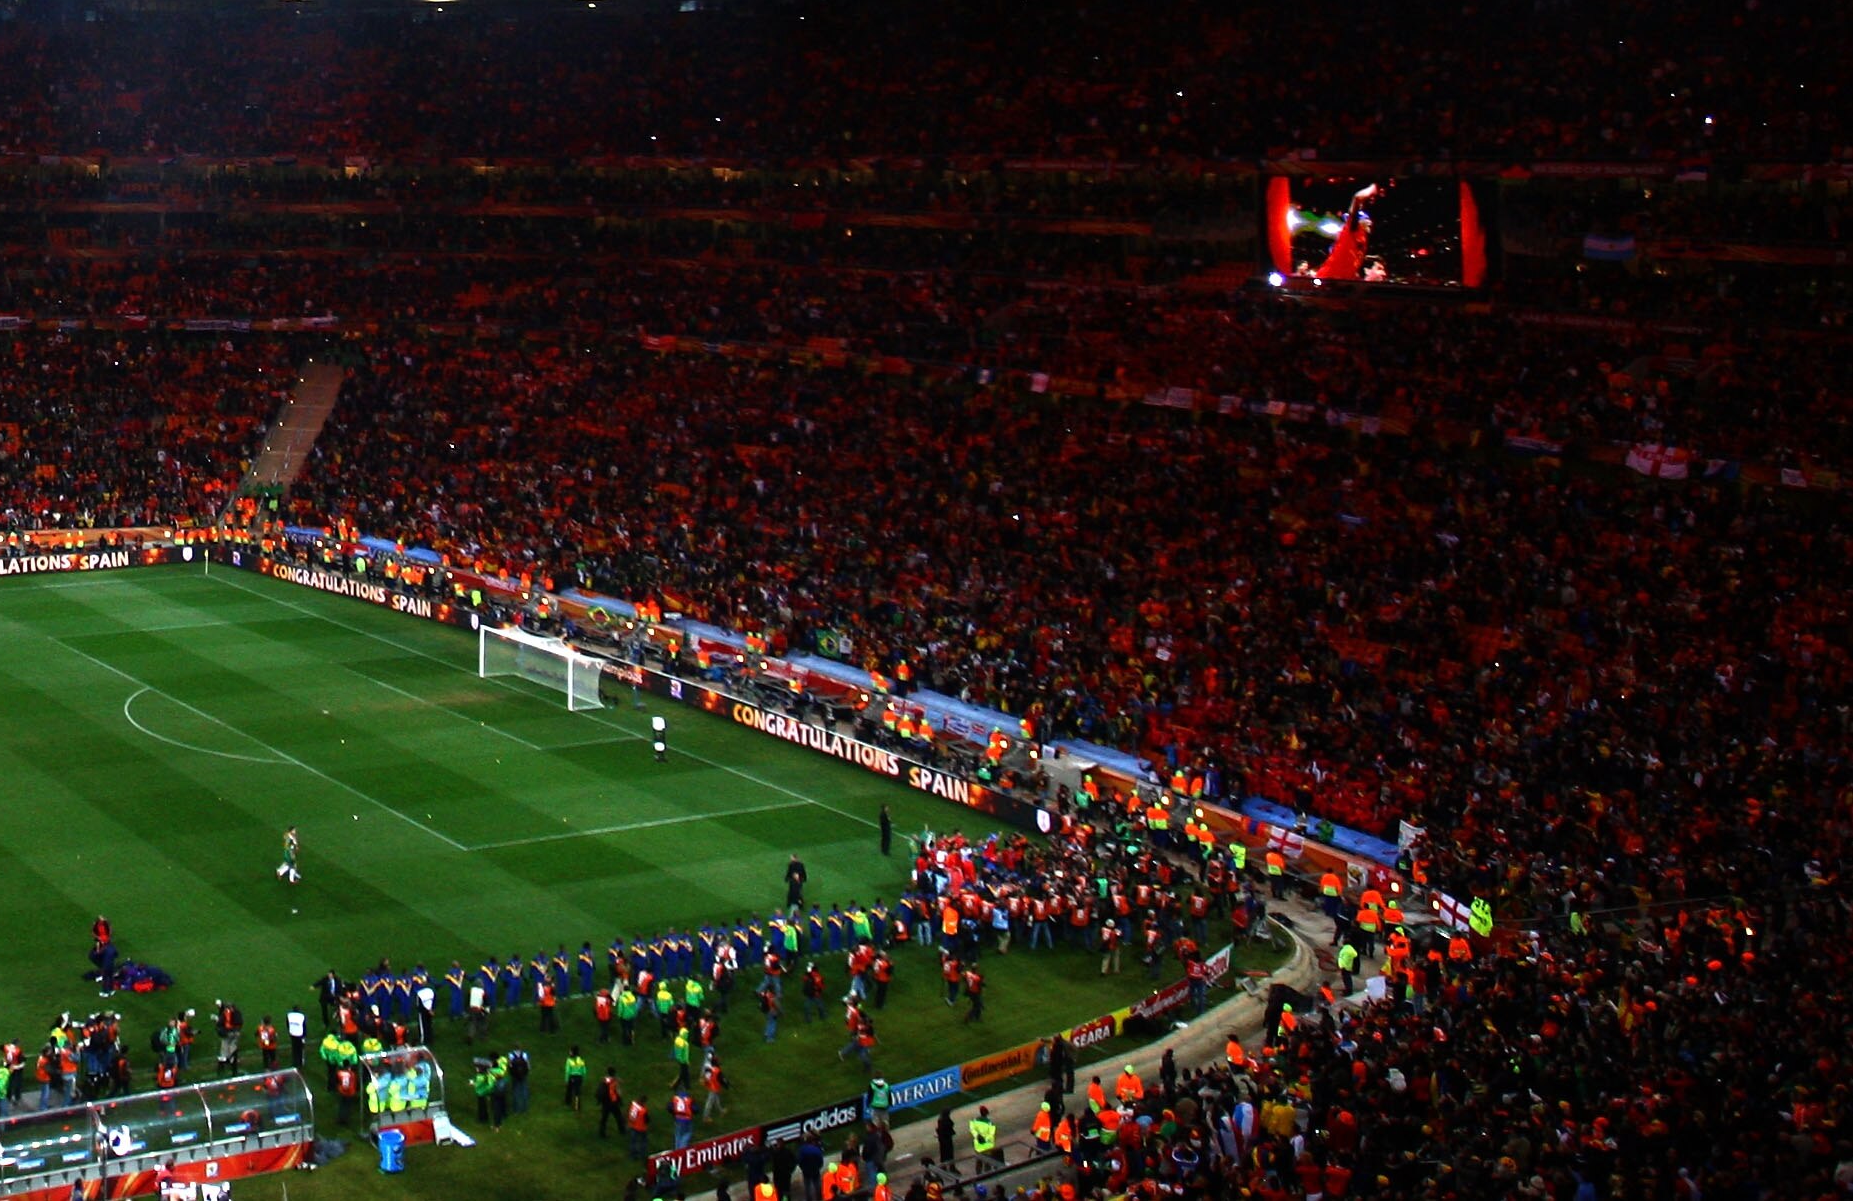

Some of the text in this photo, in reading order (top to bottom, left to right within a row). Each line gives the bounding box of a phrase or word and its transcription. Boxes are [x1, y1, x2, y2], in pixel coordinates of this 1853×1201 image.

[79, 550, 130, 571] SPAIN
[272, 564, 432, 618] CONGRATULATIONS SPAIN
[732, 702, 970, 805] CONGRATULATIONS SPAIN
[1073, 1025, 1111, 1047] SEARA
[962, 1053, 1021, 1084] Continental
[890, 1073, 956, 1107] WERADE
[803, 1104, 857, 1133] adidas
